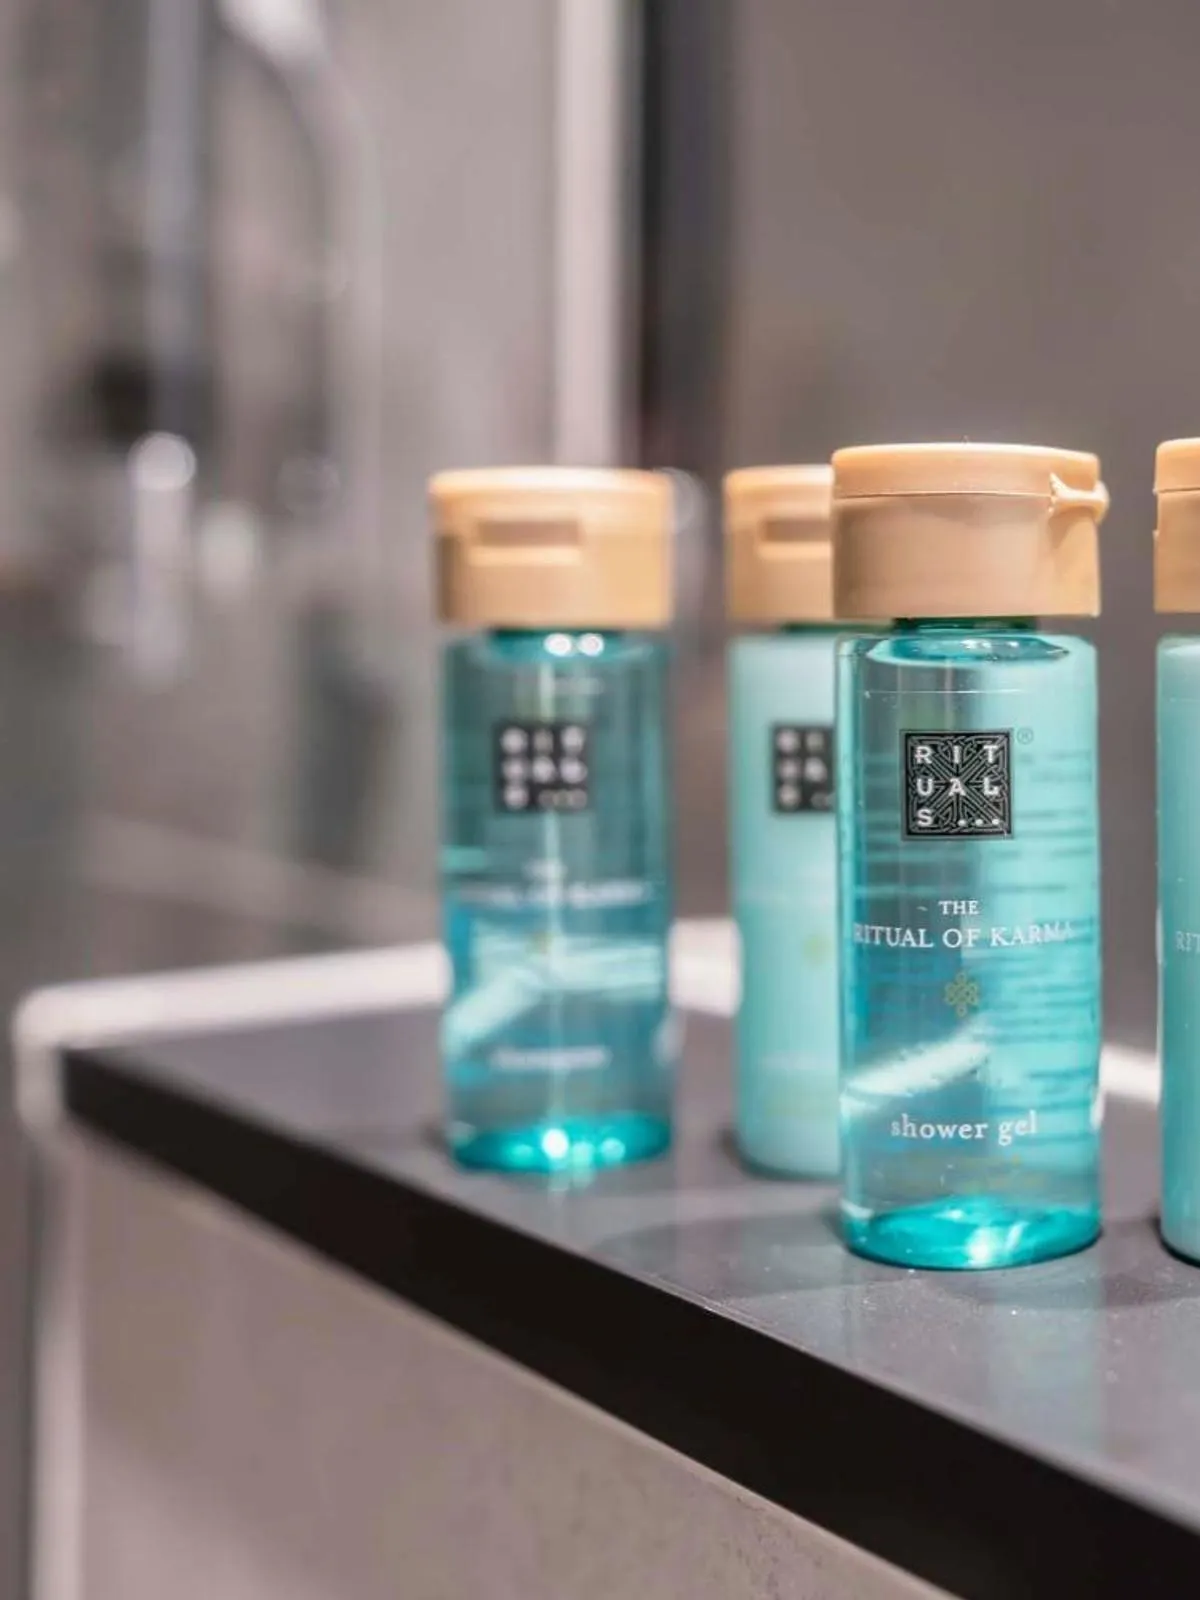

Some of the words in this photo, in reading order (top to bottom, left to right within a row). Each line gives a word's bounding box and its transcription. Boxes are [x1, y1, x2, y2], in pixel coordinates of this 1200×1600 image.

[938, 899, 981, 916] THE
[853, 922, 934, 949] RITUAL
[941, 927, 982, 949] OF
[989, 920, 1079, 948] KARMA
[890, 1112, 989, 1140] shower
[997, 1109, 1038, 1147] gel
